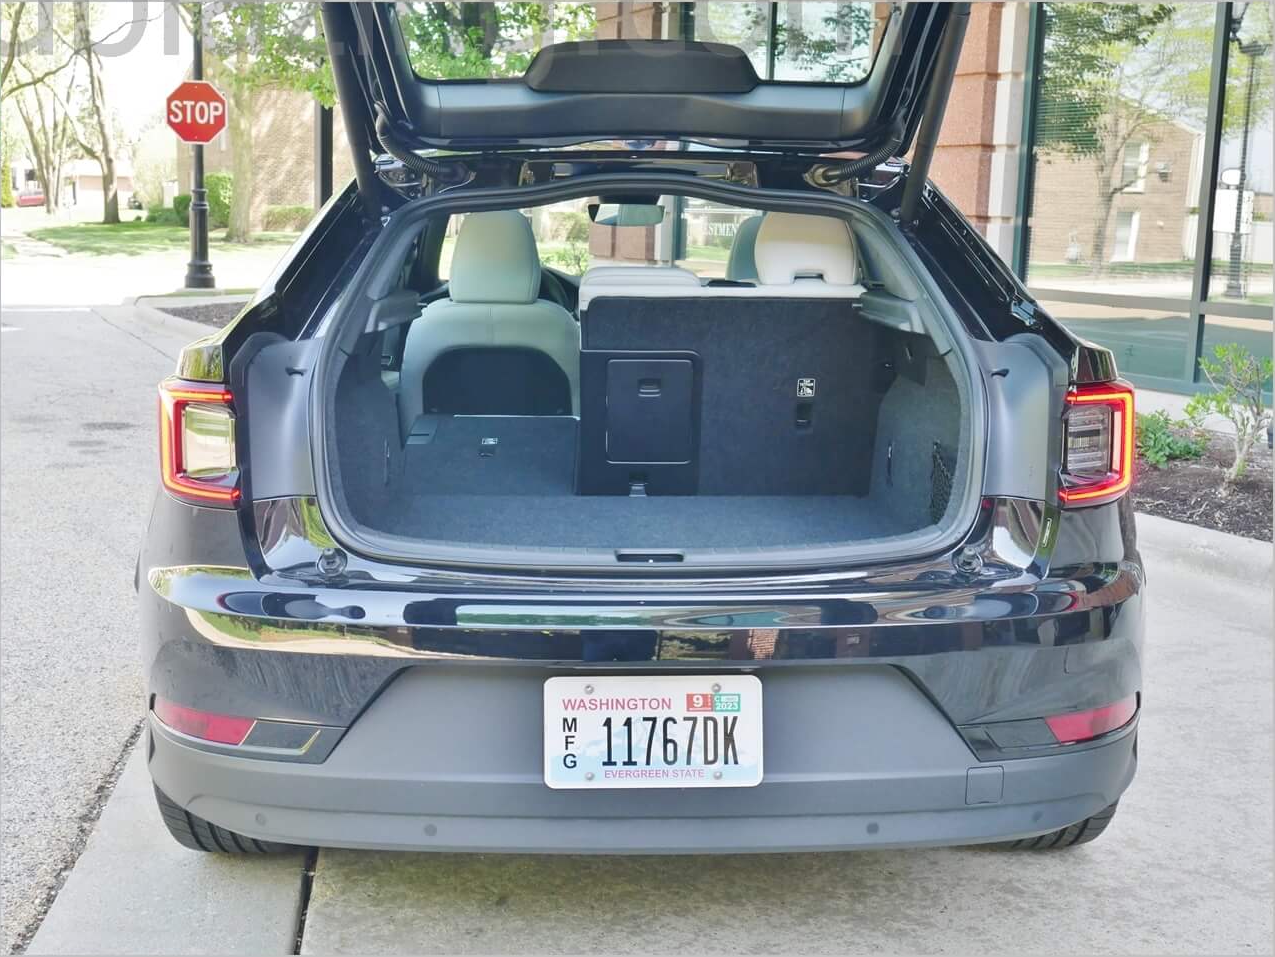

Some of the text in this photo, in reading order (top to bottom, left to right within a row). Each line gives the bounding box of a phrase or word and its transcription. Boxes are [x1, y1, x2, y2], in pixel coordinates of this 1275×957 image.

[169, 100, 223, 124] STOP
[562, 698, 672, 711] WASHINGTON
[693, 694, 703, 708] 9
[602, 716, 739, 766] 11767DK
[604, 769, 705, 779] EVERGREEN STATE
